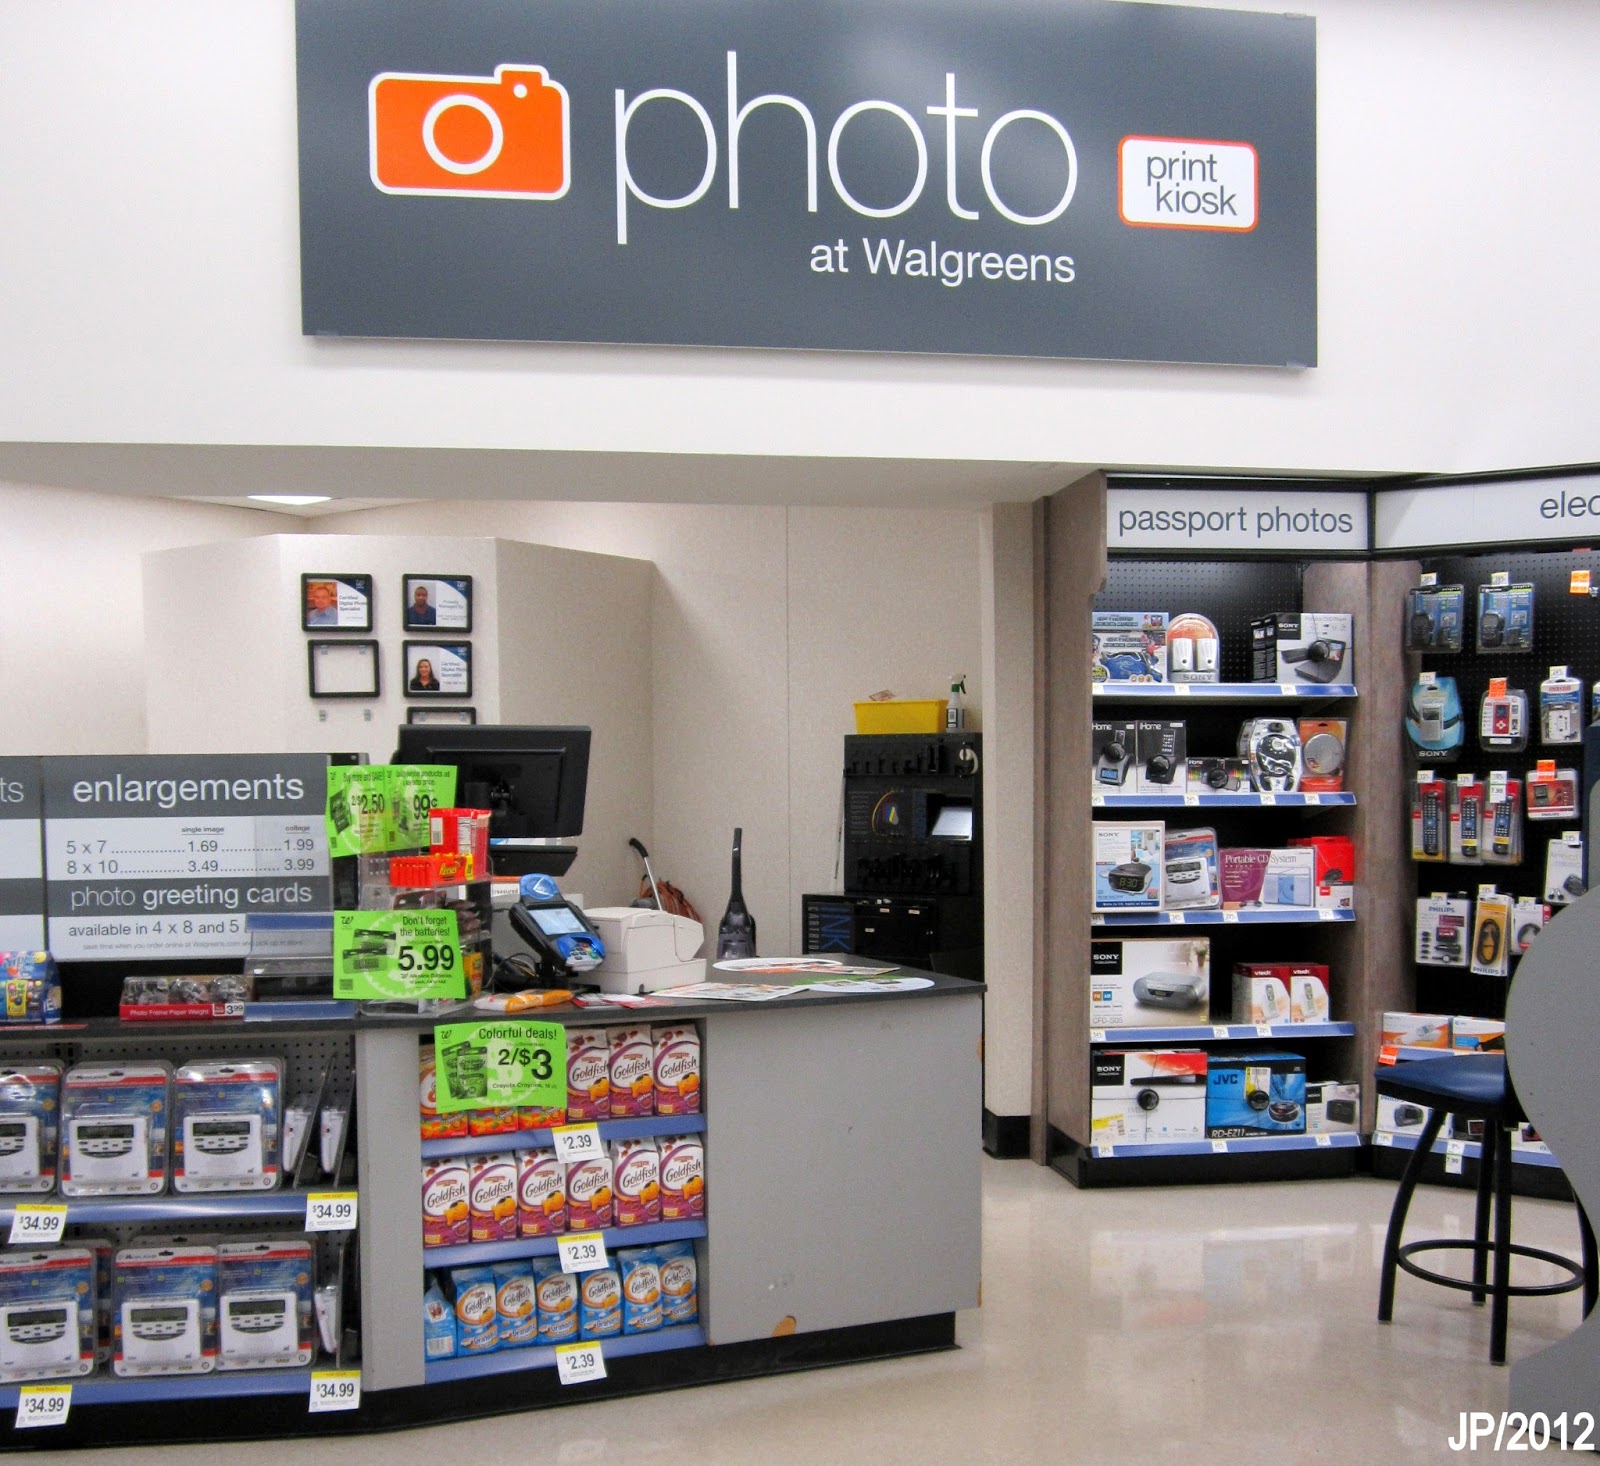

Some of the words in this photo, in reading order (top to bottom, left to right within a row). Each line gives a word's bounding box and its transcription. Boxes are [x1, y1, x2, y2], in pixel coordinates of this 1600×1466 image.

[615, 51, 1078, 243] photo
[1147, 150, 1218, 186] print
[1156, 181, 1237, 216] kiosk
[810, 238, 848, 273] at
[862, 238, 1076, 287] Walgreens
[1118, 506, 1247, 537] passport
[1257, 505, 1353, 538] photos
[1139, 723, 1162, 731] iHome
[73, 773, 304, 809] enlargements
[66, 841, 77, 854] 5
[82, 843, 91, 854] x
[97, 840, 107, 853] 7
[187, 840, 218, 853] 1.69
[284, 838, 314, 851] 1.99
[67, 861, 77, 874] 8
[83, 864, 92, 874] x
[98, 860, 118, 874] 10
[187, 859, 219, 873] 3.49
[284, 858, 314, 871] 3.99
[1225, 854, 1256, 864] Portable
[1257, 854, 1269, 864] CD
[1270, 854, 1297, 864] System
[71, 887, 136, 911] photo
[142, 884, 239, 910] greeting
[247, 882, 313, 904] cards
[68, 923, 131, 937] available
[135, 922, 148, 935] in
[152, 920, 162, 934] 4
[168, 922, 178, 934] x
[183, 919, 193, 933] 8
[198, 919, 224, 934] and
[229, 919, 239, 933] 5
[402, 916, 424, 925] Don't
[425, 916, 447, 926] forget
[820, 905, 851, 950] INK
[400, 928, 413, 937] the
[415, 927, 450, 937] batteries!
[397, 944, 454, 971] 5.99
[1473, 967, 1500, 975] PHILIPS
[478, 1027, 522, 1040] Colorful
[525, 1027, 557, 1040] deals!
[498, 1048, 553, 1080] 2/$3
[571, 1061, 609, 1082] Goldfish
[613, 1056, 651, 1080] Goldfish
[660, 1056, 697, 1079] Goldfish
[1213, 1074, 1238, 1085] JVC
[562, 1134, 592, 1150] $2.39
[622, 1164, 657, 1188] Goldfish
[665, 1159, 701, 1182] Goldfish
[525, 1173, 562, 1198] Goldfish
[573, 1169, 609, 1194] Goldfish
[427, 1183, 466, 1208] Goldfish
[474, 1179, 514, 1204] Goldfish
[312, 1204, 351, 1219] $34.99
[20, 1216, 59, 1231] $34.99
[567, 1244, 597, 1260] $2.39
[542, 1282, 571, 1301] Goldfish
[588, 1280, 616, 1298] Goldfish
[631, 1274, 657, 1294] Goldfish
[465, 1294, 492, 1314] Goldfish
[566, 1353, 595, 1370] $2.39
[316, 1382, 355, 1398] $34.99
[25, 1397, 65, 1413] $34.99
